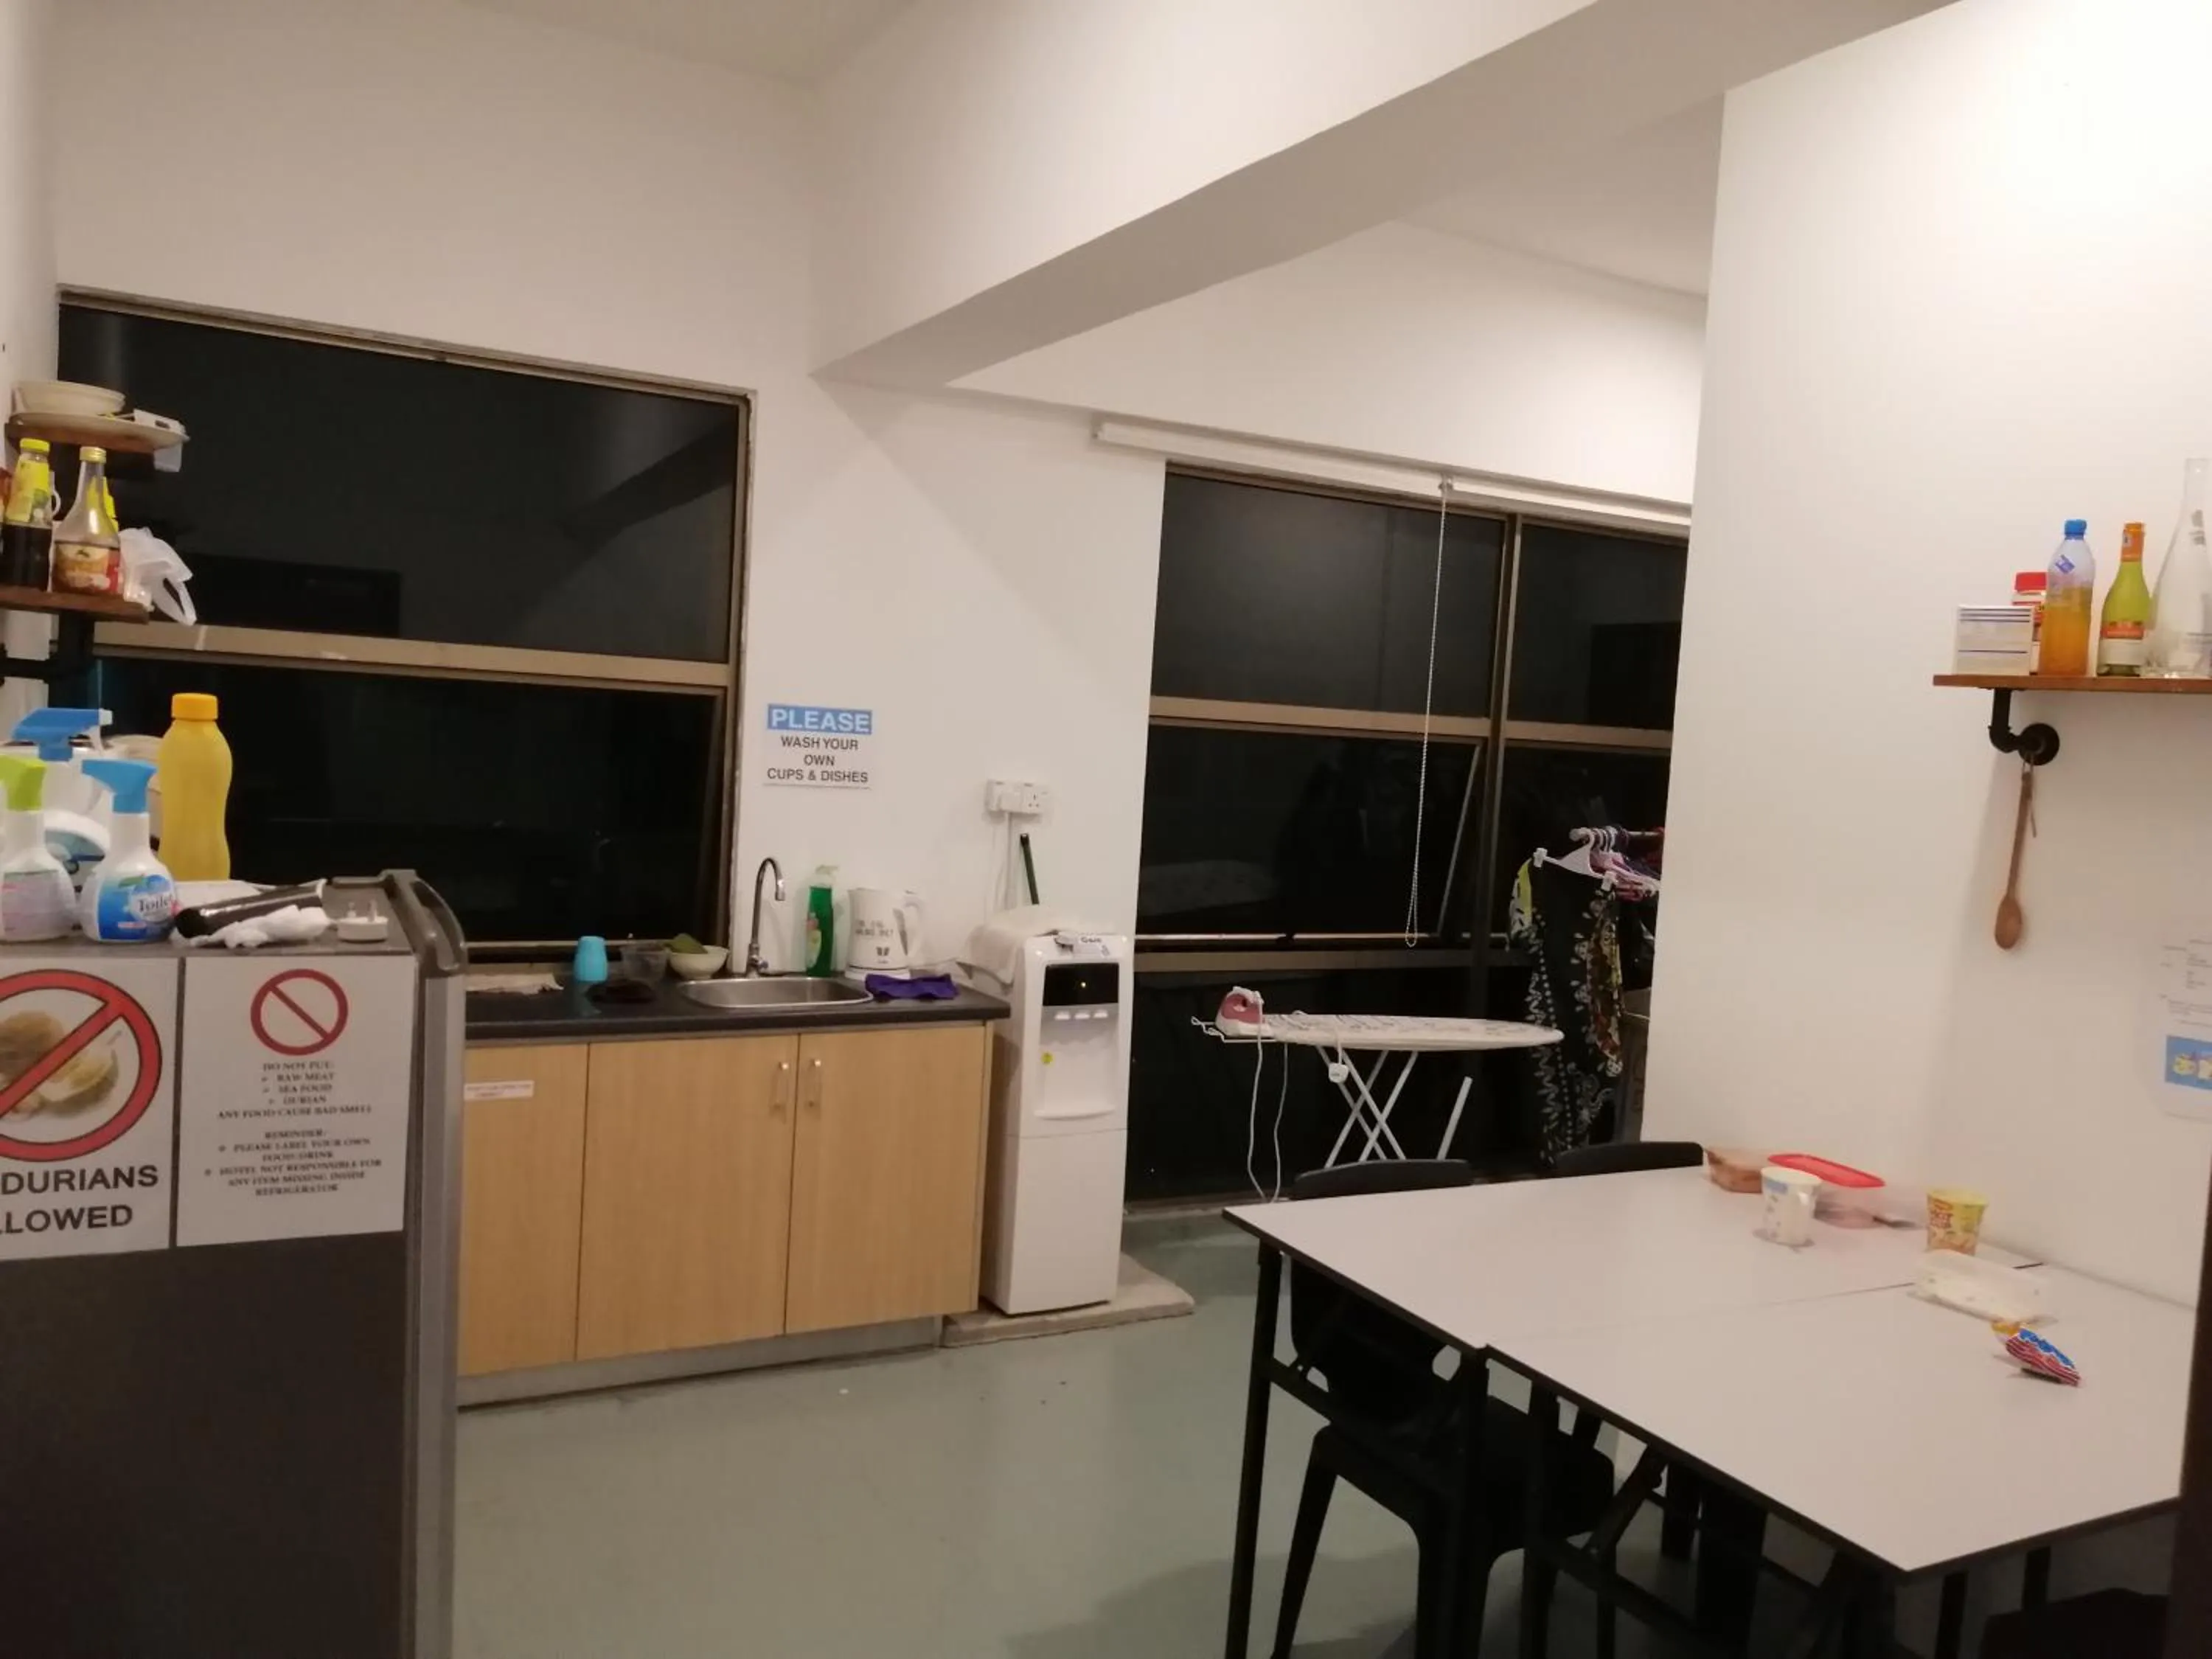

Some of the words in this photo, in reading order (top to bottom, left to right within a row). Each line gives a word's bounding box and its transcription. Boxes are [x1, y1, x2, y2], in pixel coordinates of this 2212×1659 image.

[771, 709, 869, 732] PLEASE
[780, 736, 820, 749] WASH
[823, 738, 859, 751] YOUR
[804, 754, 835, 766] OWN
[767, 768, 804, 781] CUPS
[808, 770, 816, 782] &
[821, 771, 869, 783] DISHES
[263, 1062, 280, 1071] DO
[282, 1062, 305, 1071] NOT
[277, 1074, 302, 1082] RAW
[305, 1072, 334, 1082] MEAT
[279, 1085, 298, 1093] SEA
[300, 1083, 333, 1093] FOOD
[283, 1095, 327, 1105] DURIAN
[219, 1110, 240, 1119] ANY
[243, 1108, 276, 1118] FOOD
[278, 1107, 311, 1116] CAUSE
[314, 1105, 338, 1115] BAD
[234, 1142, 272, 1152] PLEASE
[275, 1141, 307, 1150] LABEL
[311, 1139, 341, 1149] YOUR
[344, 1138, 371, 1146] OWN
[260, 1165, 284, 1174] NOT
[287, 1161, 357, 1172] RESPONSIBLE
[360, 1159, 382, 1168] FOR
[1, 1165, 159, 1194] DURIANS
[0, 1205, 133, 1234] LOWED
